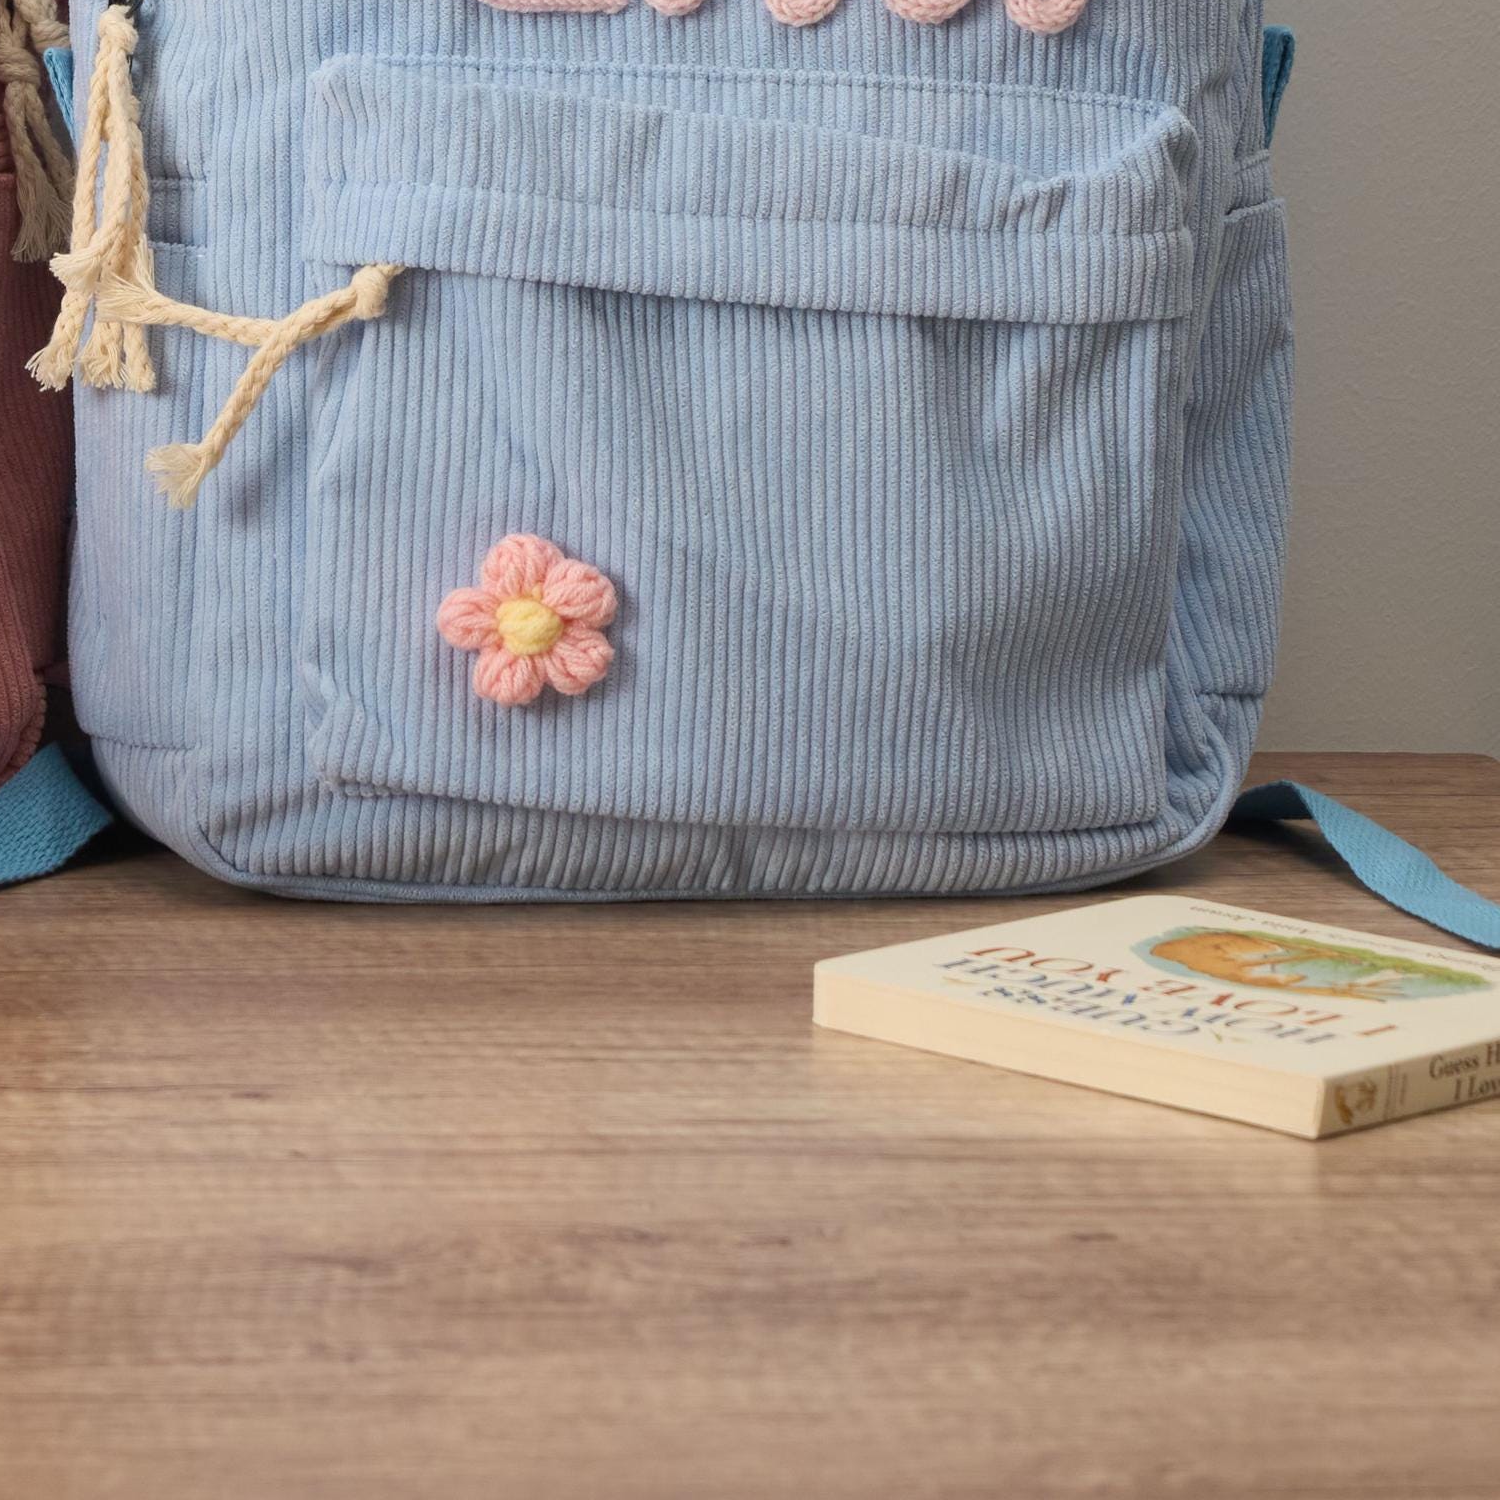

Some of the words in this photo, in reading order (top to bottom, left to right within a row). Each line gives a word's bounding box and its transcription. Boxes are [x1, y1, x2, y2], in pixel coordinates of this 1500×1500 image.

[934, 958, 1158, 1006] MUCH
[964, 946, 1130, 984] YOU
[977, 986, 1200, 1036] GUESS
[1136, 978, 1350, 1026] LOVE
[1153, 1006, 1340, 1045] HOW
[1355, 1023, 1400, 1038] I
[1429, 1053, 1480, 1081] Guess
